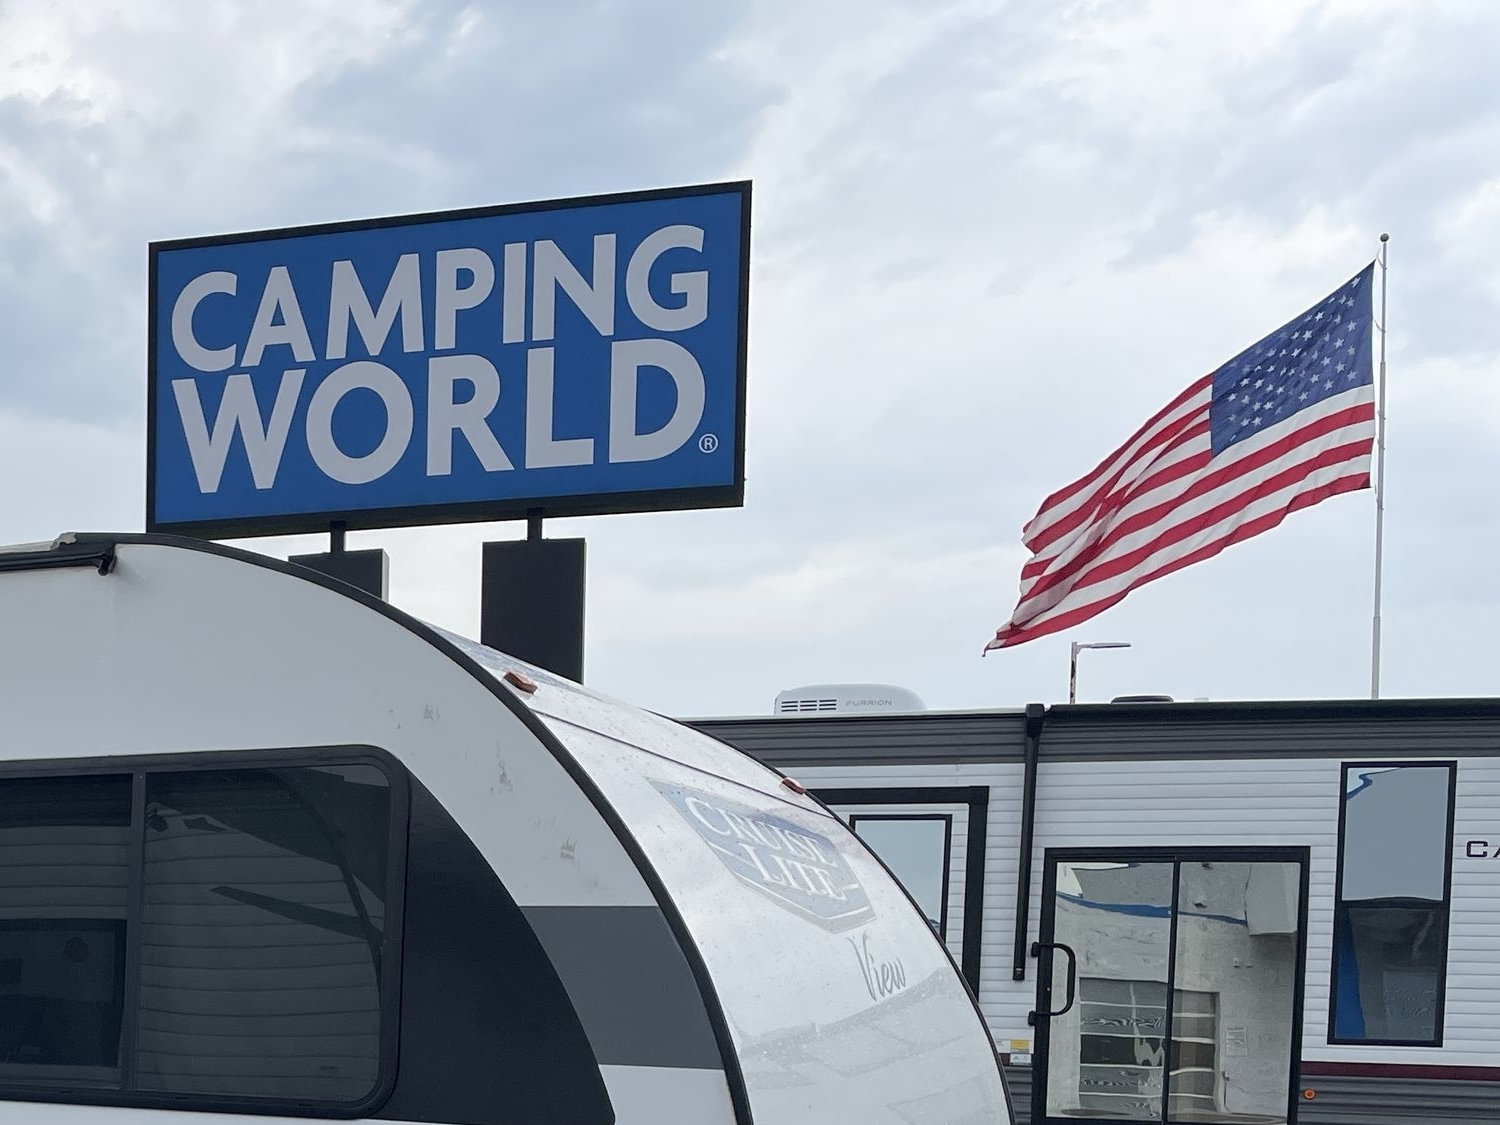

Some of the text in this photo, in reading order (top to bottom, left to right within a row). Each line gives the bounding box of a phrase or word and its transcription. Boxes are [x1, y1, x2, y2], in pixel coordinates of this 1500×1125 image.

[171, 224, 709, 372] CAMPING
[845, 699, 893, 707] FURRION
[846, 930, 906, 1001] View
